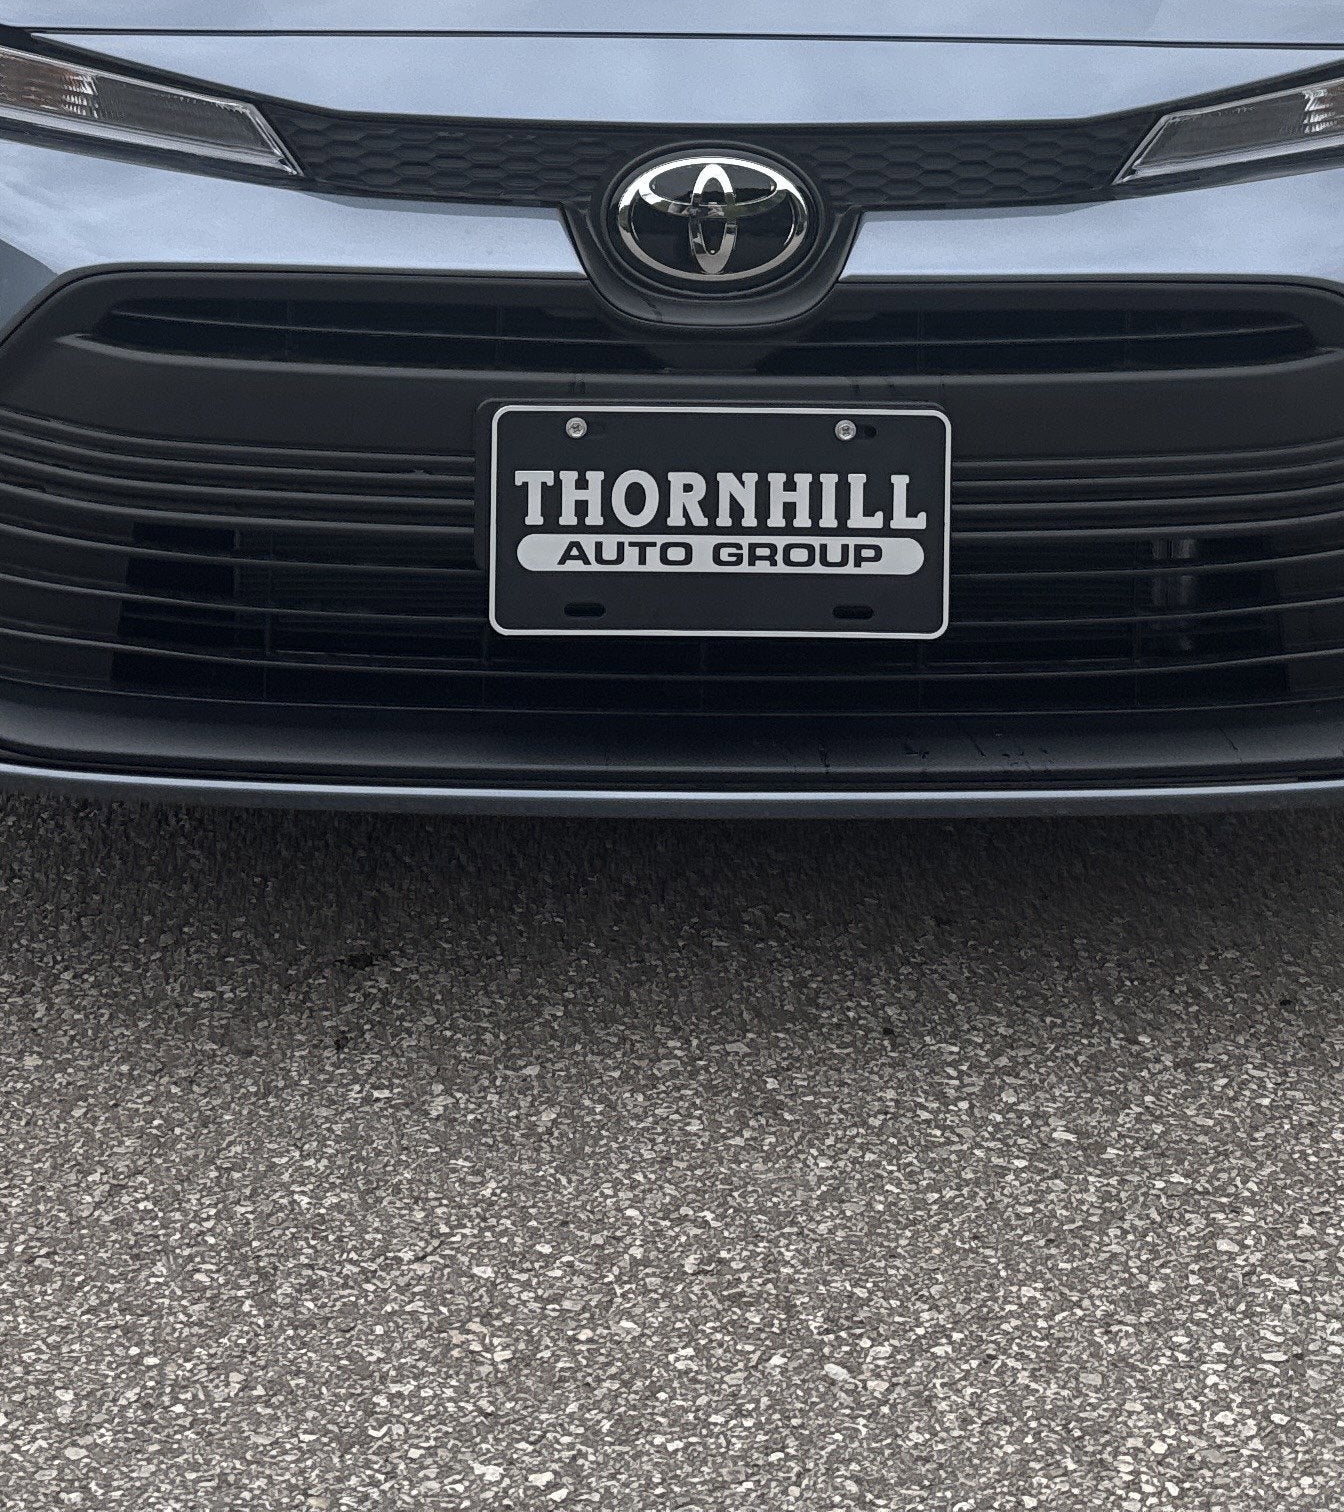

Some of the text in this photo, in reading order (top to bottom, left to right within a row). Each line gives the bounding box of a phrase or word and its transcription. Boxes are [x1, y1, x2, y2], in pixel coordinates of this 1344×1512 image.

[514, 469, 927, 530] THORNHILL
[556, 540, 884, 569] AUTO GROUP
